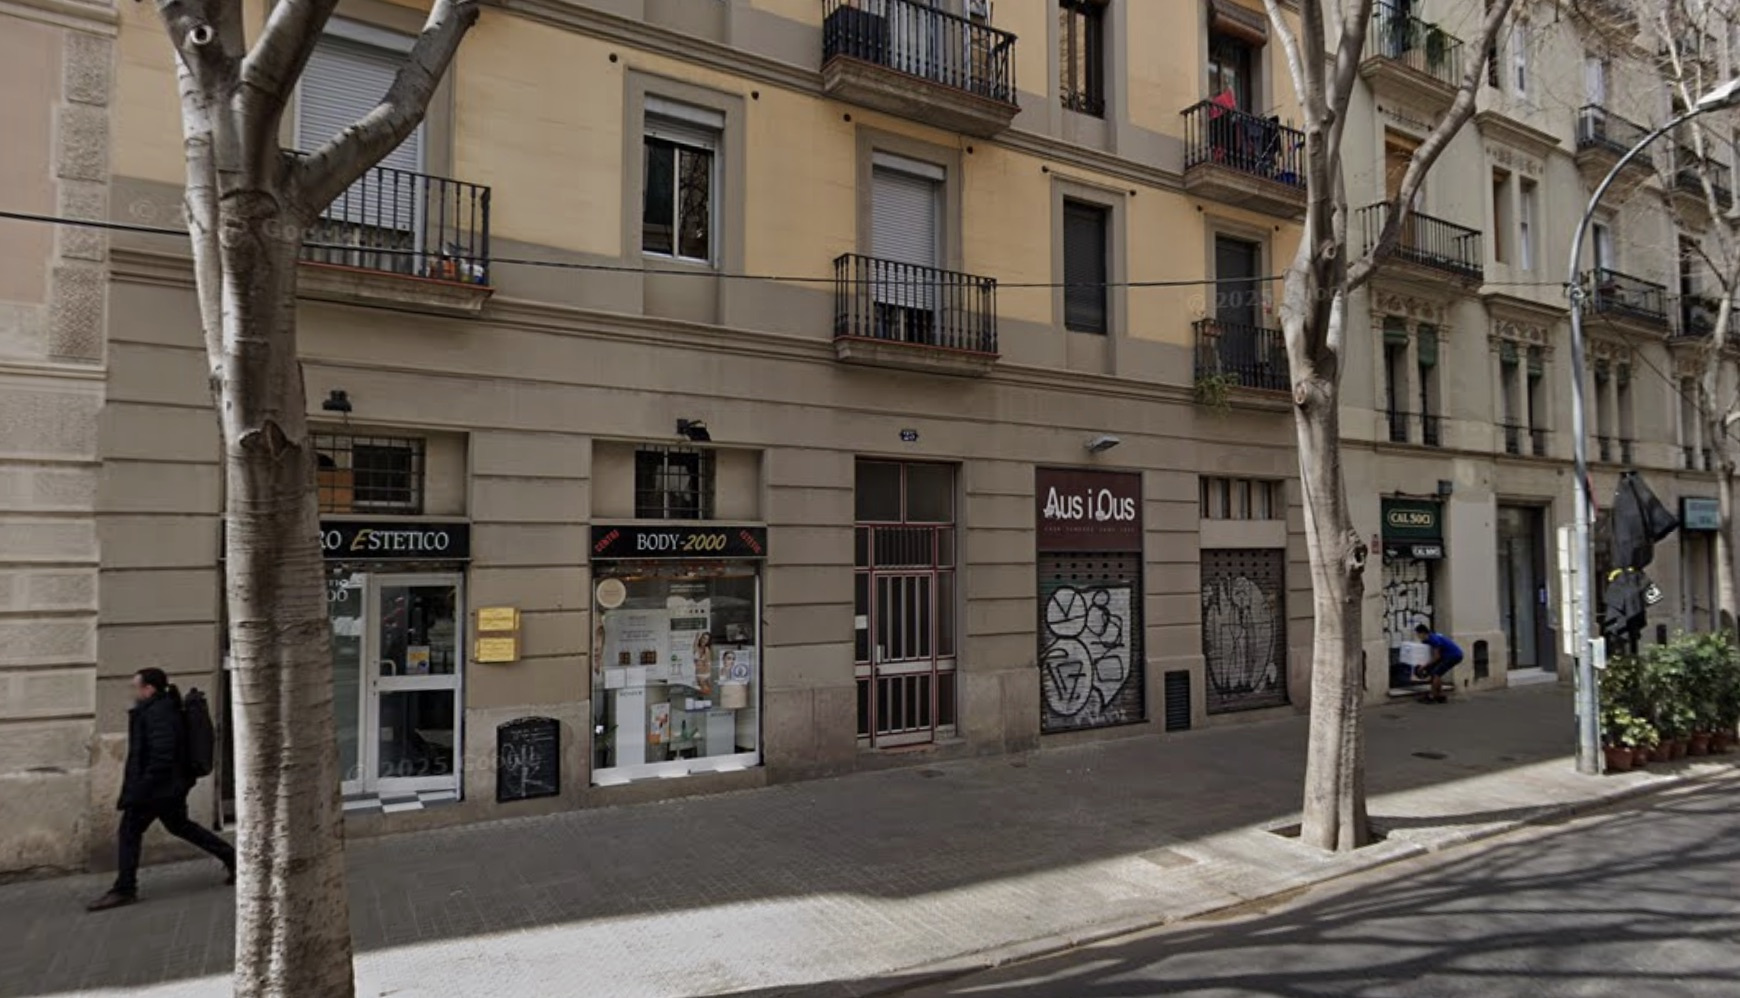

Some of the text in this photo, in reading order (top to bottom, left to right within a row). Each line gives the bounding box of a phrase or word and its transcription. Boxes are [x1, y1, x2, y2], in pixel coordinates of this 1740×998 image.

[1044, 486, 1135, 521] Aus i Ous
[1390, 512, 1409, 523] CAL
[351, 528, 450, 551] ESTETICO
[636, 532, 727, 551] BODY-2000
